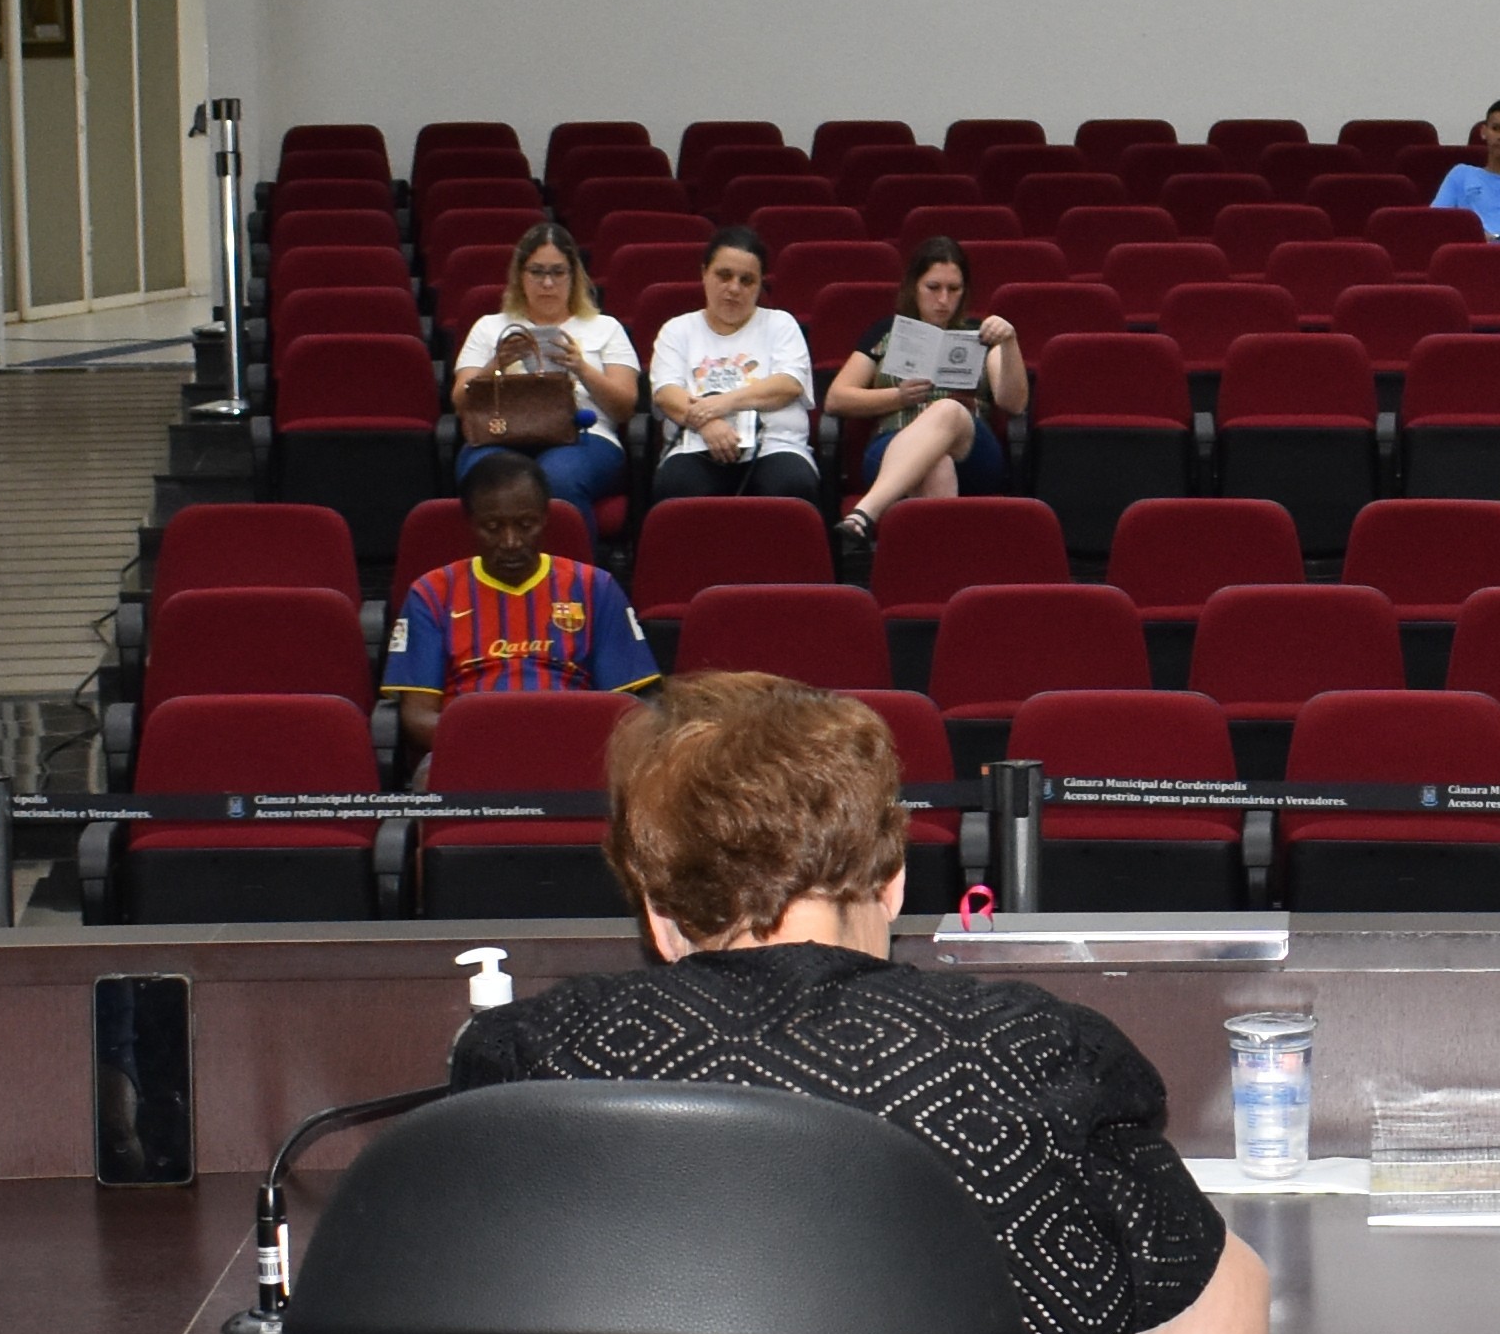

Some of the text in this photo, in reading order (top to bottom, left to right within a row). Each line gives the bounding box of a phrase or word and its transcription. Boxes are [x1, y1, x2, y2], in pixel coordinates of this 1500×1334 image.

[488, 638, 554, 658] Qatar
[1063, 777, 1247, 792] Câmara Municipal de Cordeirópolis
[1448, 785, 1488, 795] Câmara
[298, 794, 352, 805] Municipal
[353, 794, 368, 803] de
[1063, 791, 1100, 801] Acesso
[1101, 792, 1141, 802] restrito
[1143, 795, 1180, 804] apenas
[1182, 796, 1207, 805] para
[1448, 798, 1484, 808] Acesso
[12, 808, 77, 818] uncionários
[255, 809, 293, 819] Acesso
[294, 808, 335, 818] restrito
[336, 809, 375, 819] apenas
[377, 809, 402, 819] para
